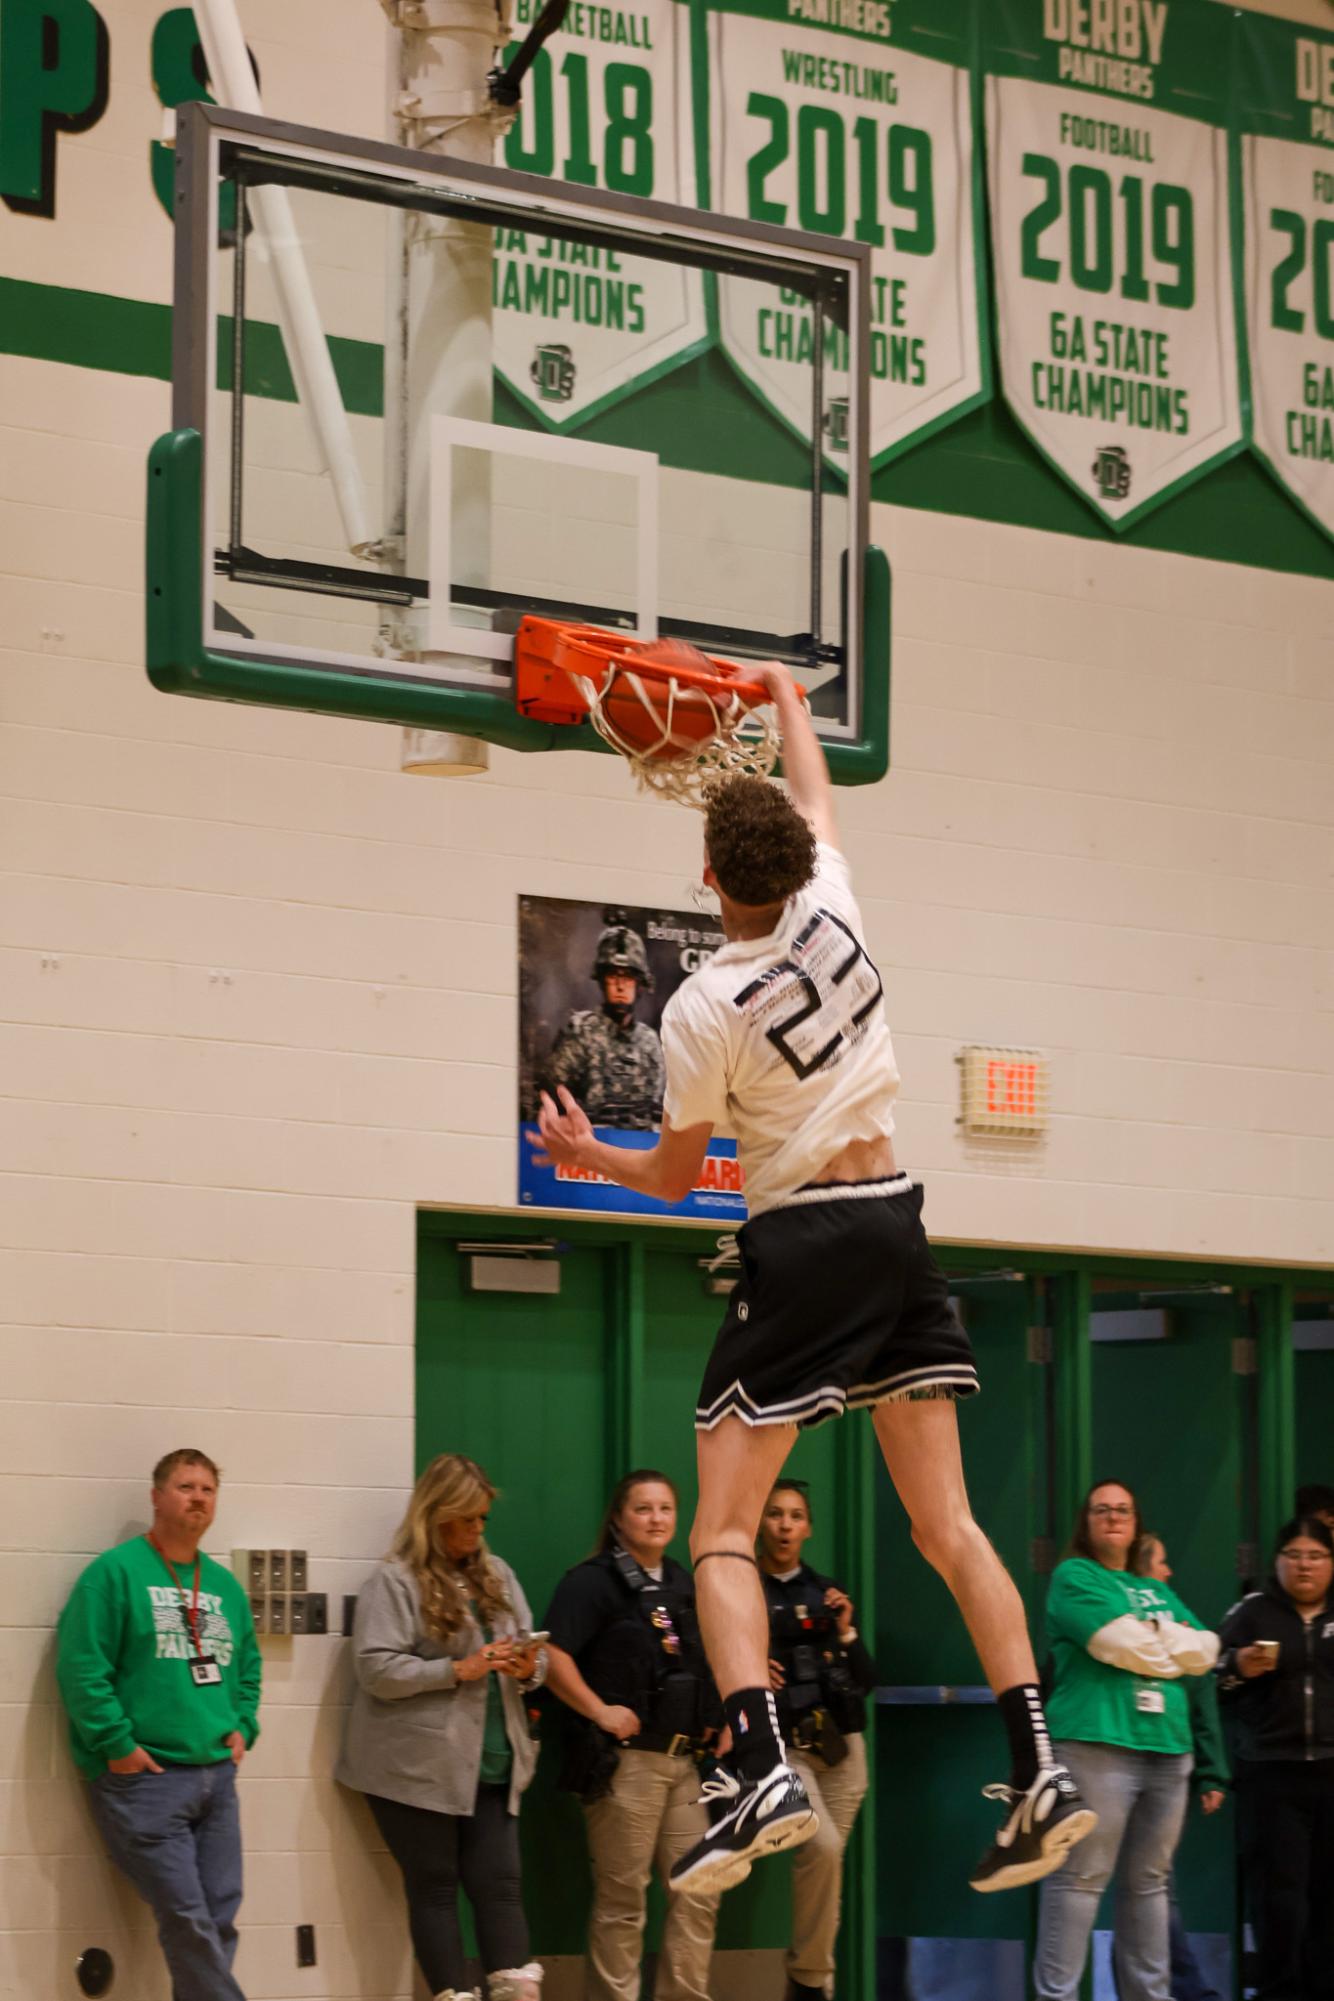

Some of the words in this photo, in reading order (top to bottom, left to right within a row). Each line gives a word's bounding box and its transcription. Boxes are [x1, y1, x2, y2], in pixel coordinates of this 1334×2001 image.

[516, 0, 653, 50] BAKETBALL
[1043, 0, 1168, 65] DERBY
[782, 49, 898, 106] WRESTLING
[1059, 47, 1154, 99] PANTHERS
[502, 40, 654, 198] 018
[1060, 112, 1155, 163] FOOTBALL
[746, 91, 936, 258] 2019
[1020, 152, 1195, 311] 2019
[492, 257, 645, 334] AMPIONS
[758, 308, 926, 387] CHAMONS
[1050, 311, 1087, 364] 6A
[1094, 320, 1169, 379] STATE
[1032, 361, 1189, 436] CHAMPIONS
